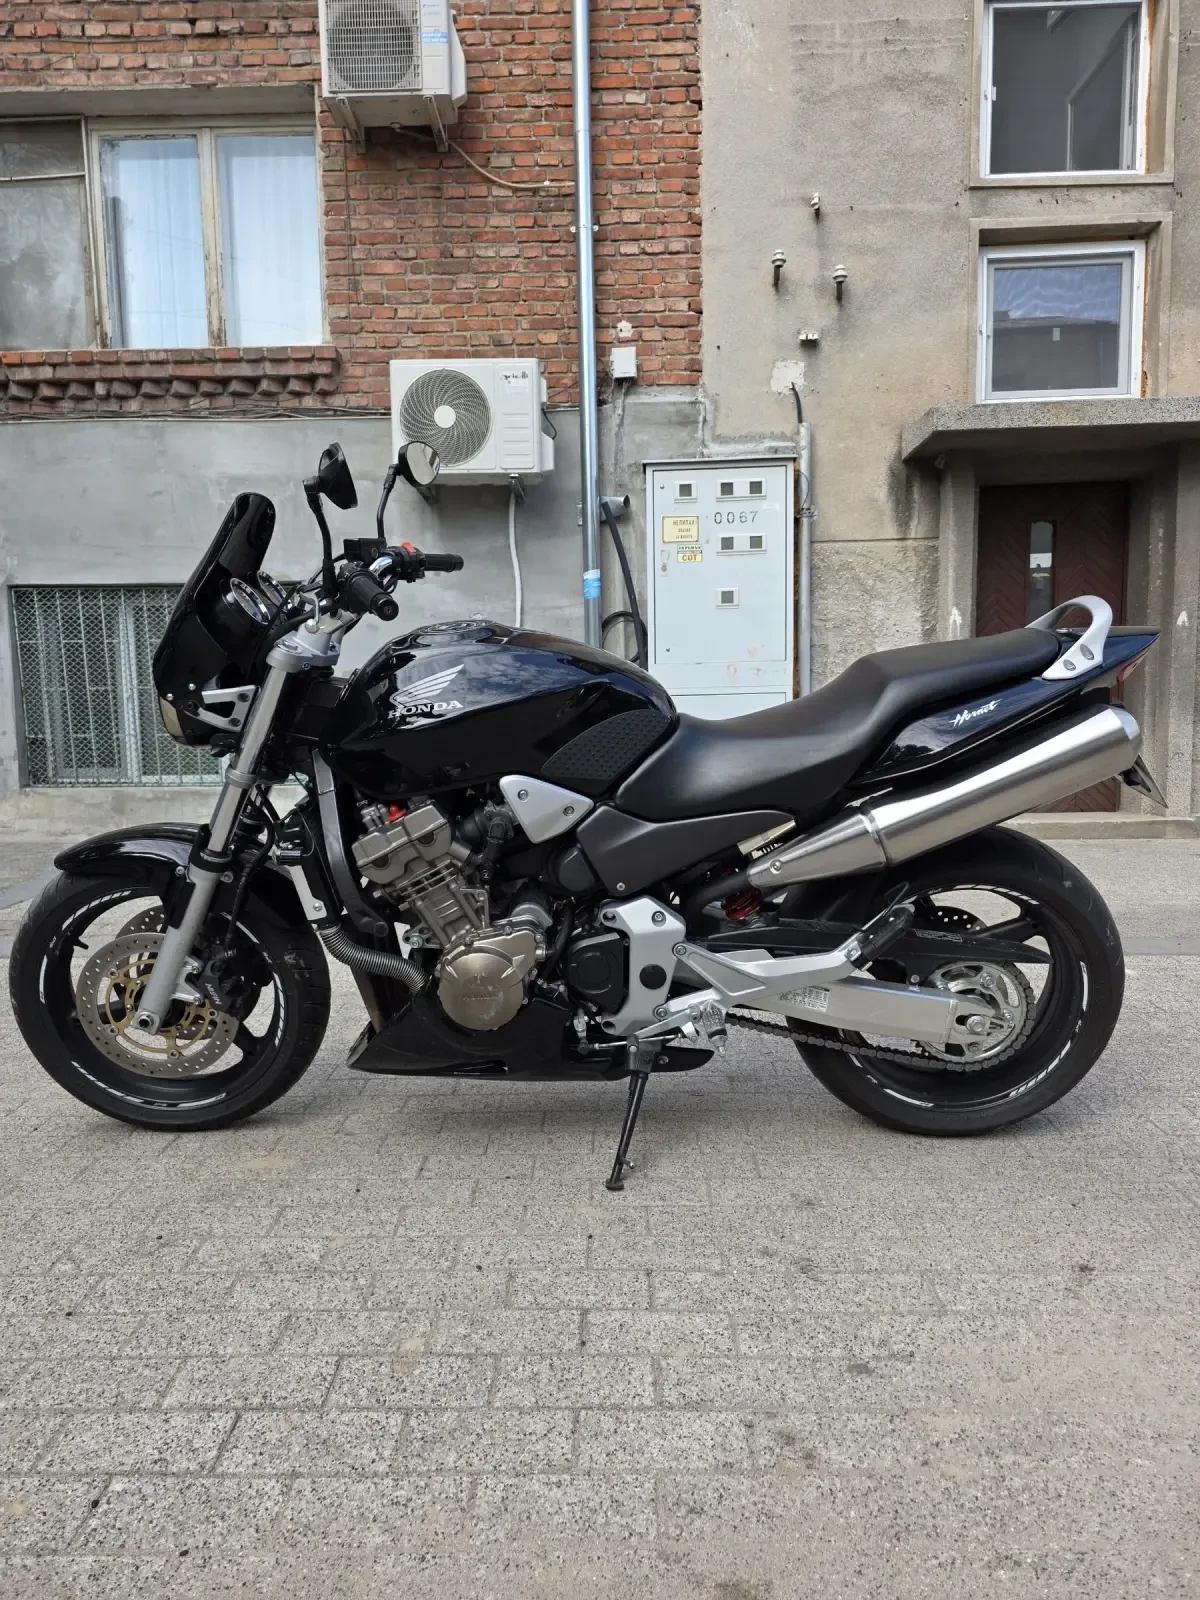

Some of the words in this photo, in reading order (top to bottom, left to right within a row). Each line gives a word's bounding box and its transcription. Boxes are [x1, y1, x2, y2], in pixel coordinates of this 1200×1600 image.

[714, 510, 758, 525] 0067
[387, 700, 464, 720] HONDA
[948, 698, 1003, 728] Hornet
